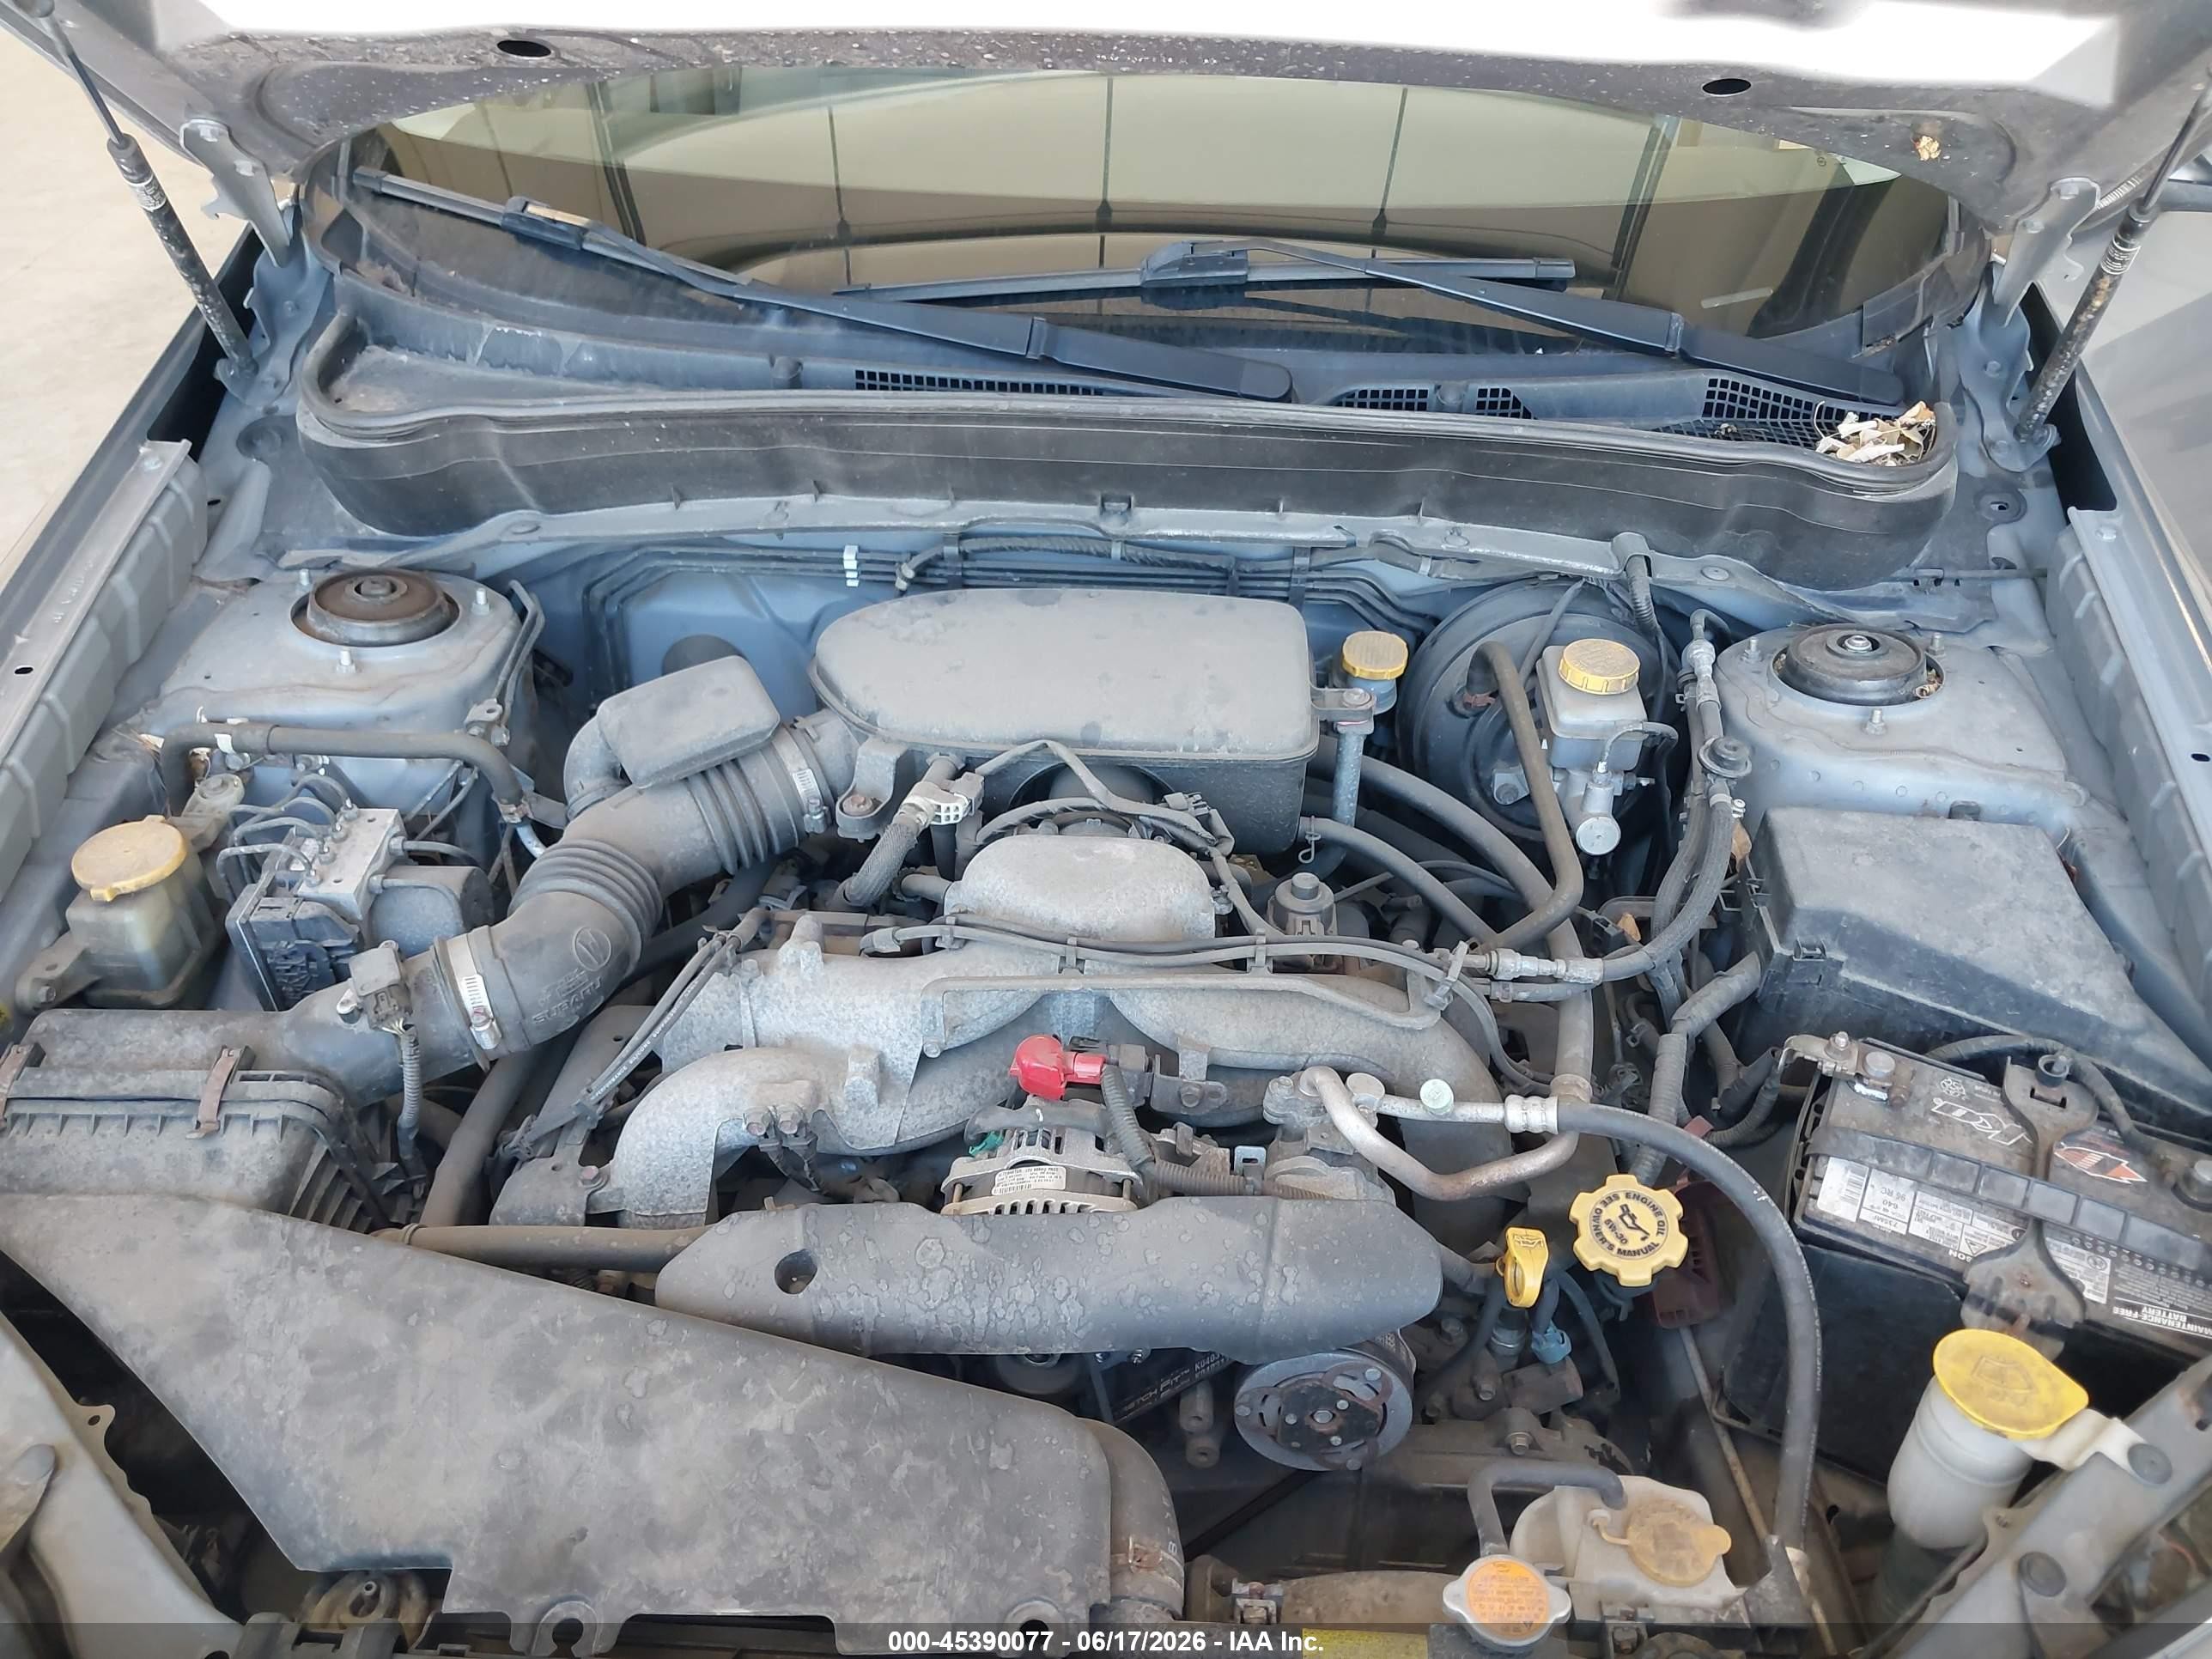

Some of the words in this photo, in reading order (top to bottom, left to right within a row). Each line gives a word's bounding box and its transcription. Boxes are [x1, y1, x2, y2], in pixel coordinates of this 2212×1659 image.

[1600, 1193, 1620, 1208] SEE
[1625, 1192, 1663, 1218] ENGINE
[1656, 1220, 1666, 1237] OIL
[1592, 1207, 1615, 1252] OWNER'S
[1616, 1242, 1660, 1257] MANUAL
[2141, 1306, 2187, 1323] BATTERY
